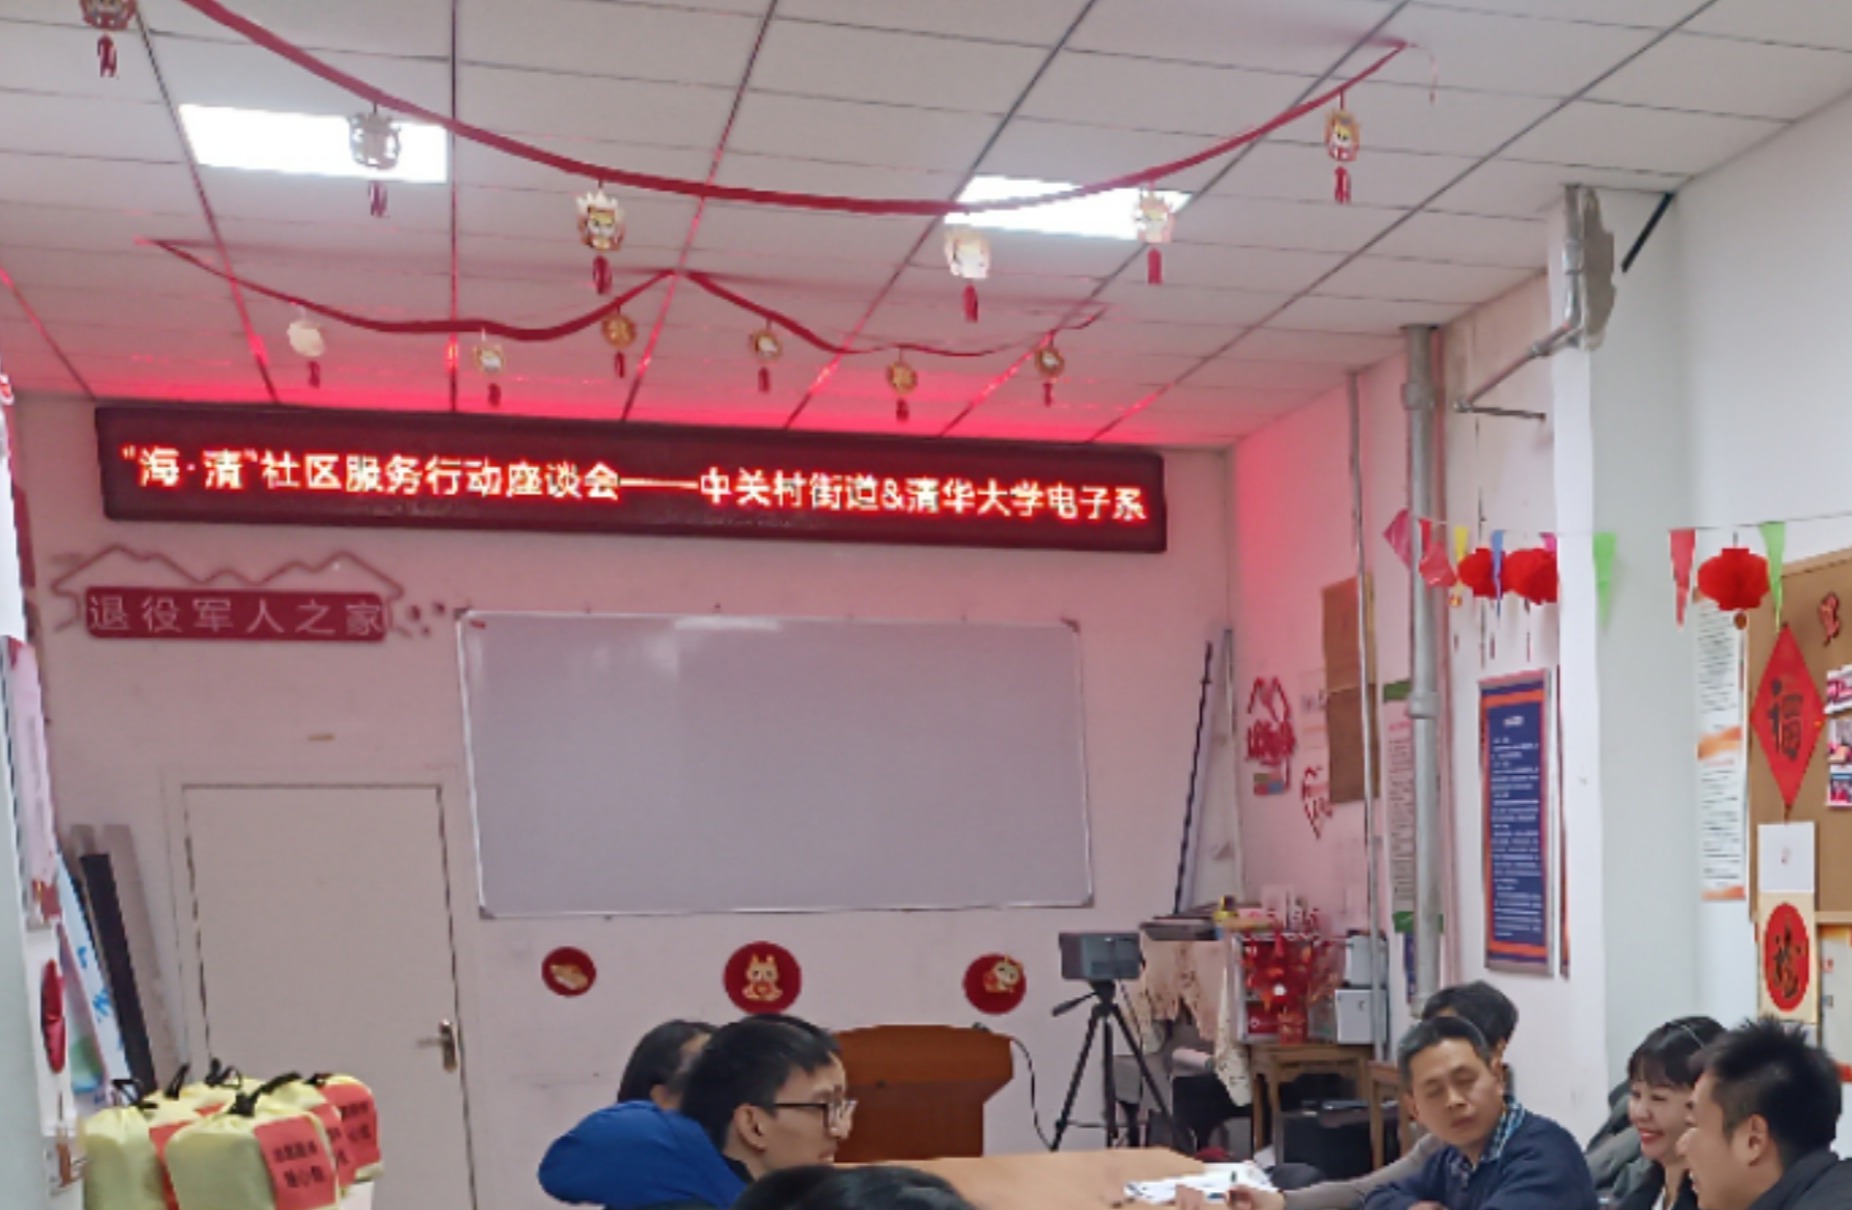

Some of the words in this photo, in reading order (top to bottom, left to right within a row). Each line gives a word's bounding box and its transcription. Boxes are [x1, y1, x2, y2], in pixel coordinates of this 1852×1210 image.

[88, 596, 386, 636] 退役军人之家
